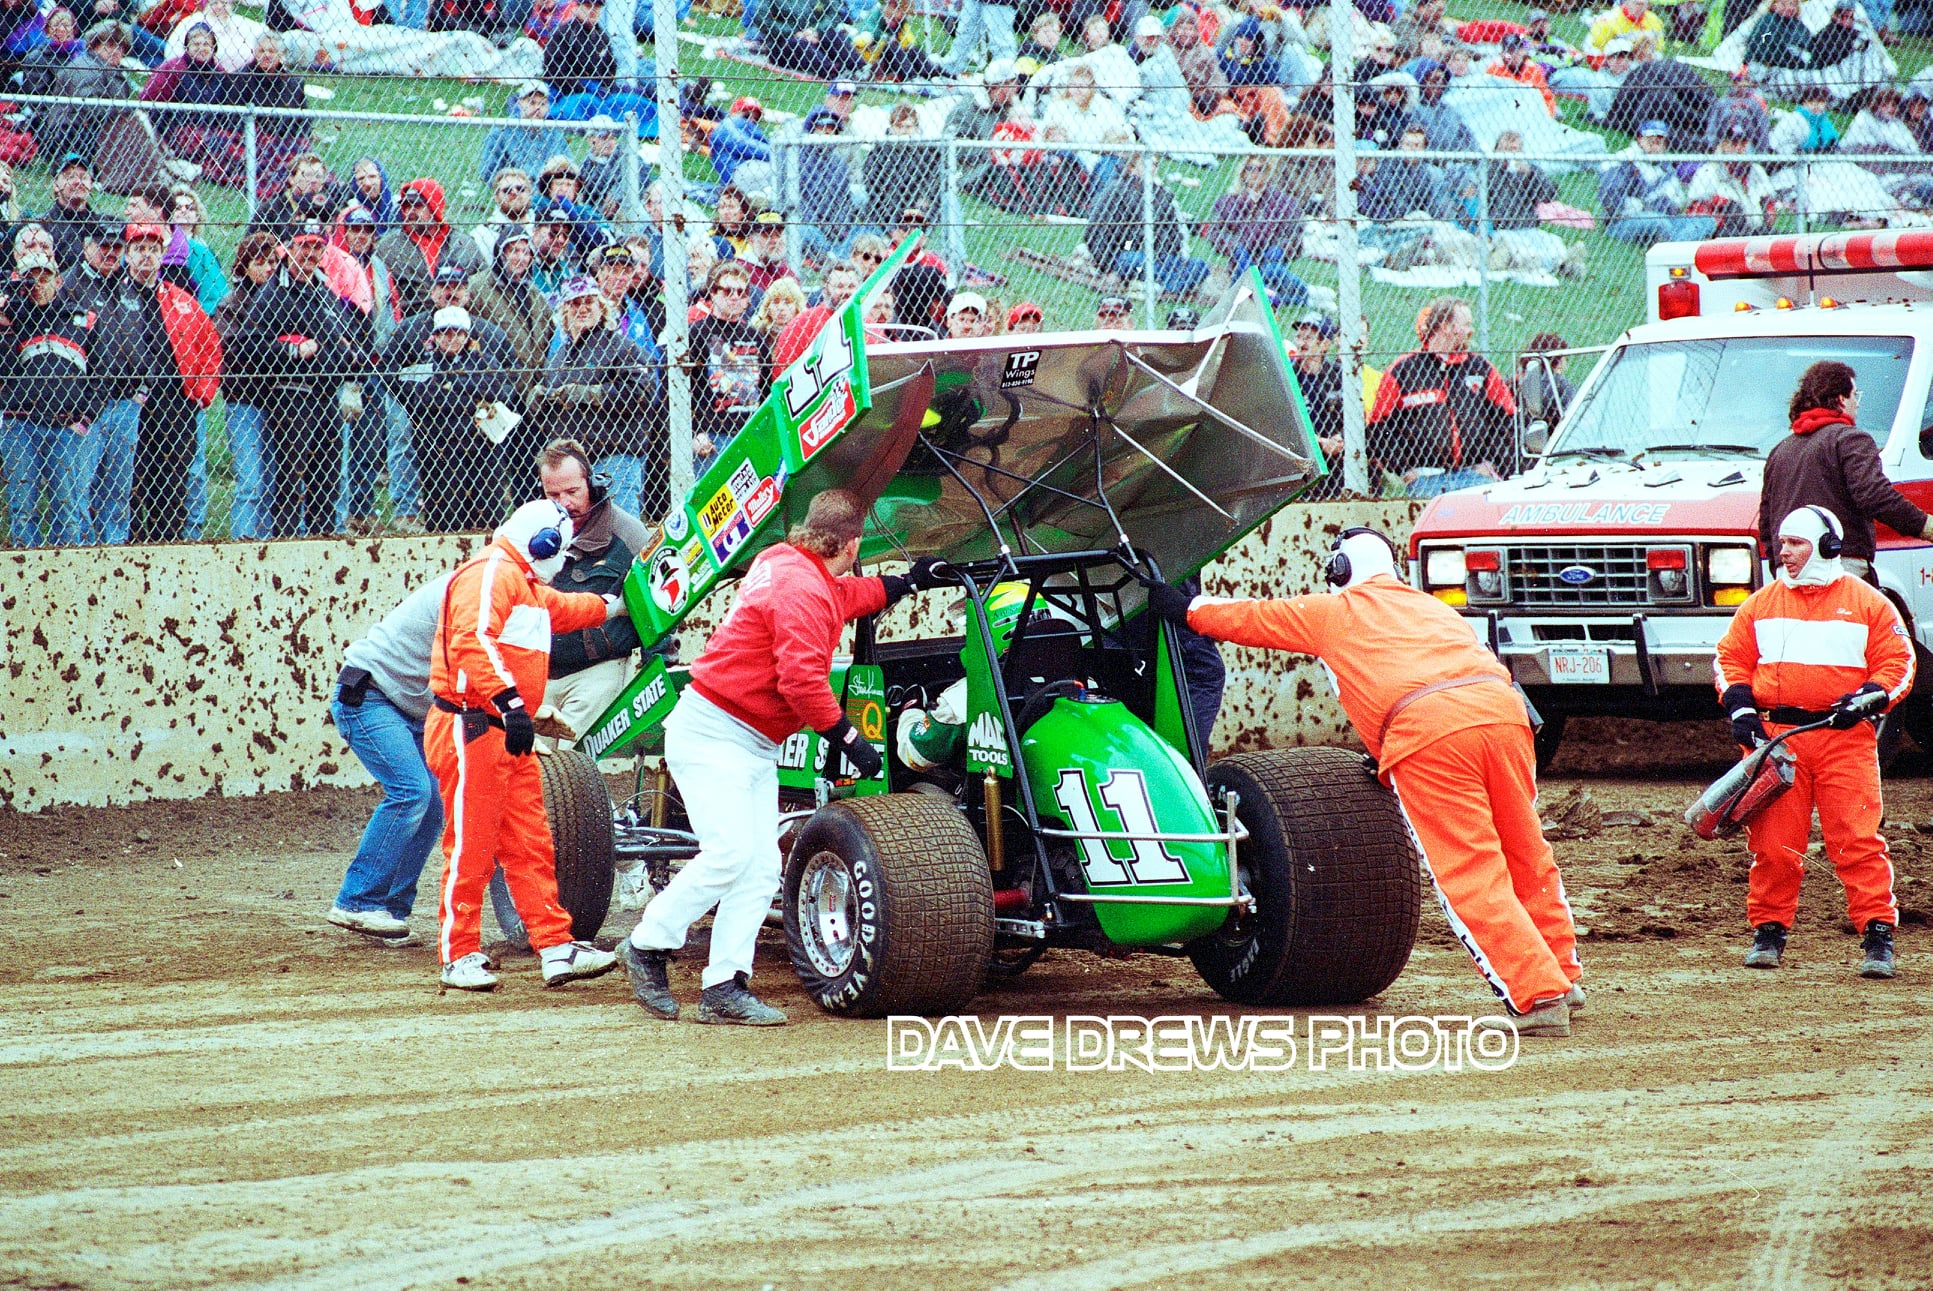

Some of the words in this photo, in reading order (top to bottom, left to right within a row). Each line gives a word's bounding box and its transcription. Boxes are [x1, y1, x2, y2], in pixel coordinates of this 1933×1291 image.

[1011, 351, 1040, 369] TP
[1005, 369, 1035, 378] Wings
[709, 492, 727, 515] Auto
[711, 498, 734, 526] Meter
[1500, 503, 1672, 525] AMBULANCE
[1555, 657, 1602, 673] NRJ-206
[583, 708, 631, 763] QUAKER
[633, 673, 666, 719] STATE
[861, 702, 884, 740] Q
[968, 711, 1006, 750] MAC
[969, 749, 1008, 766] TOOLS
[1052, 768, 1194, 888] 11
